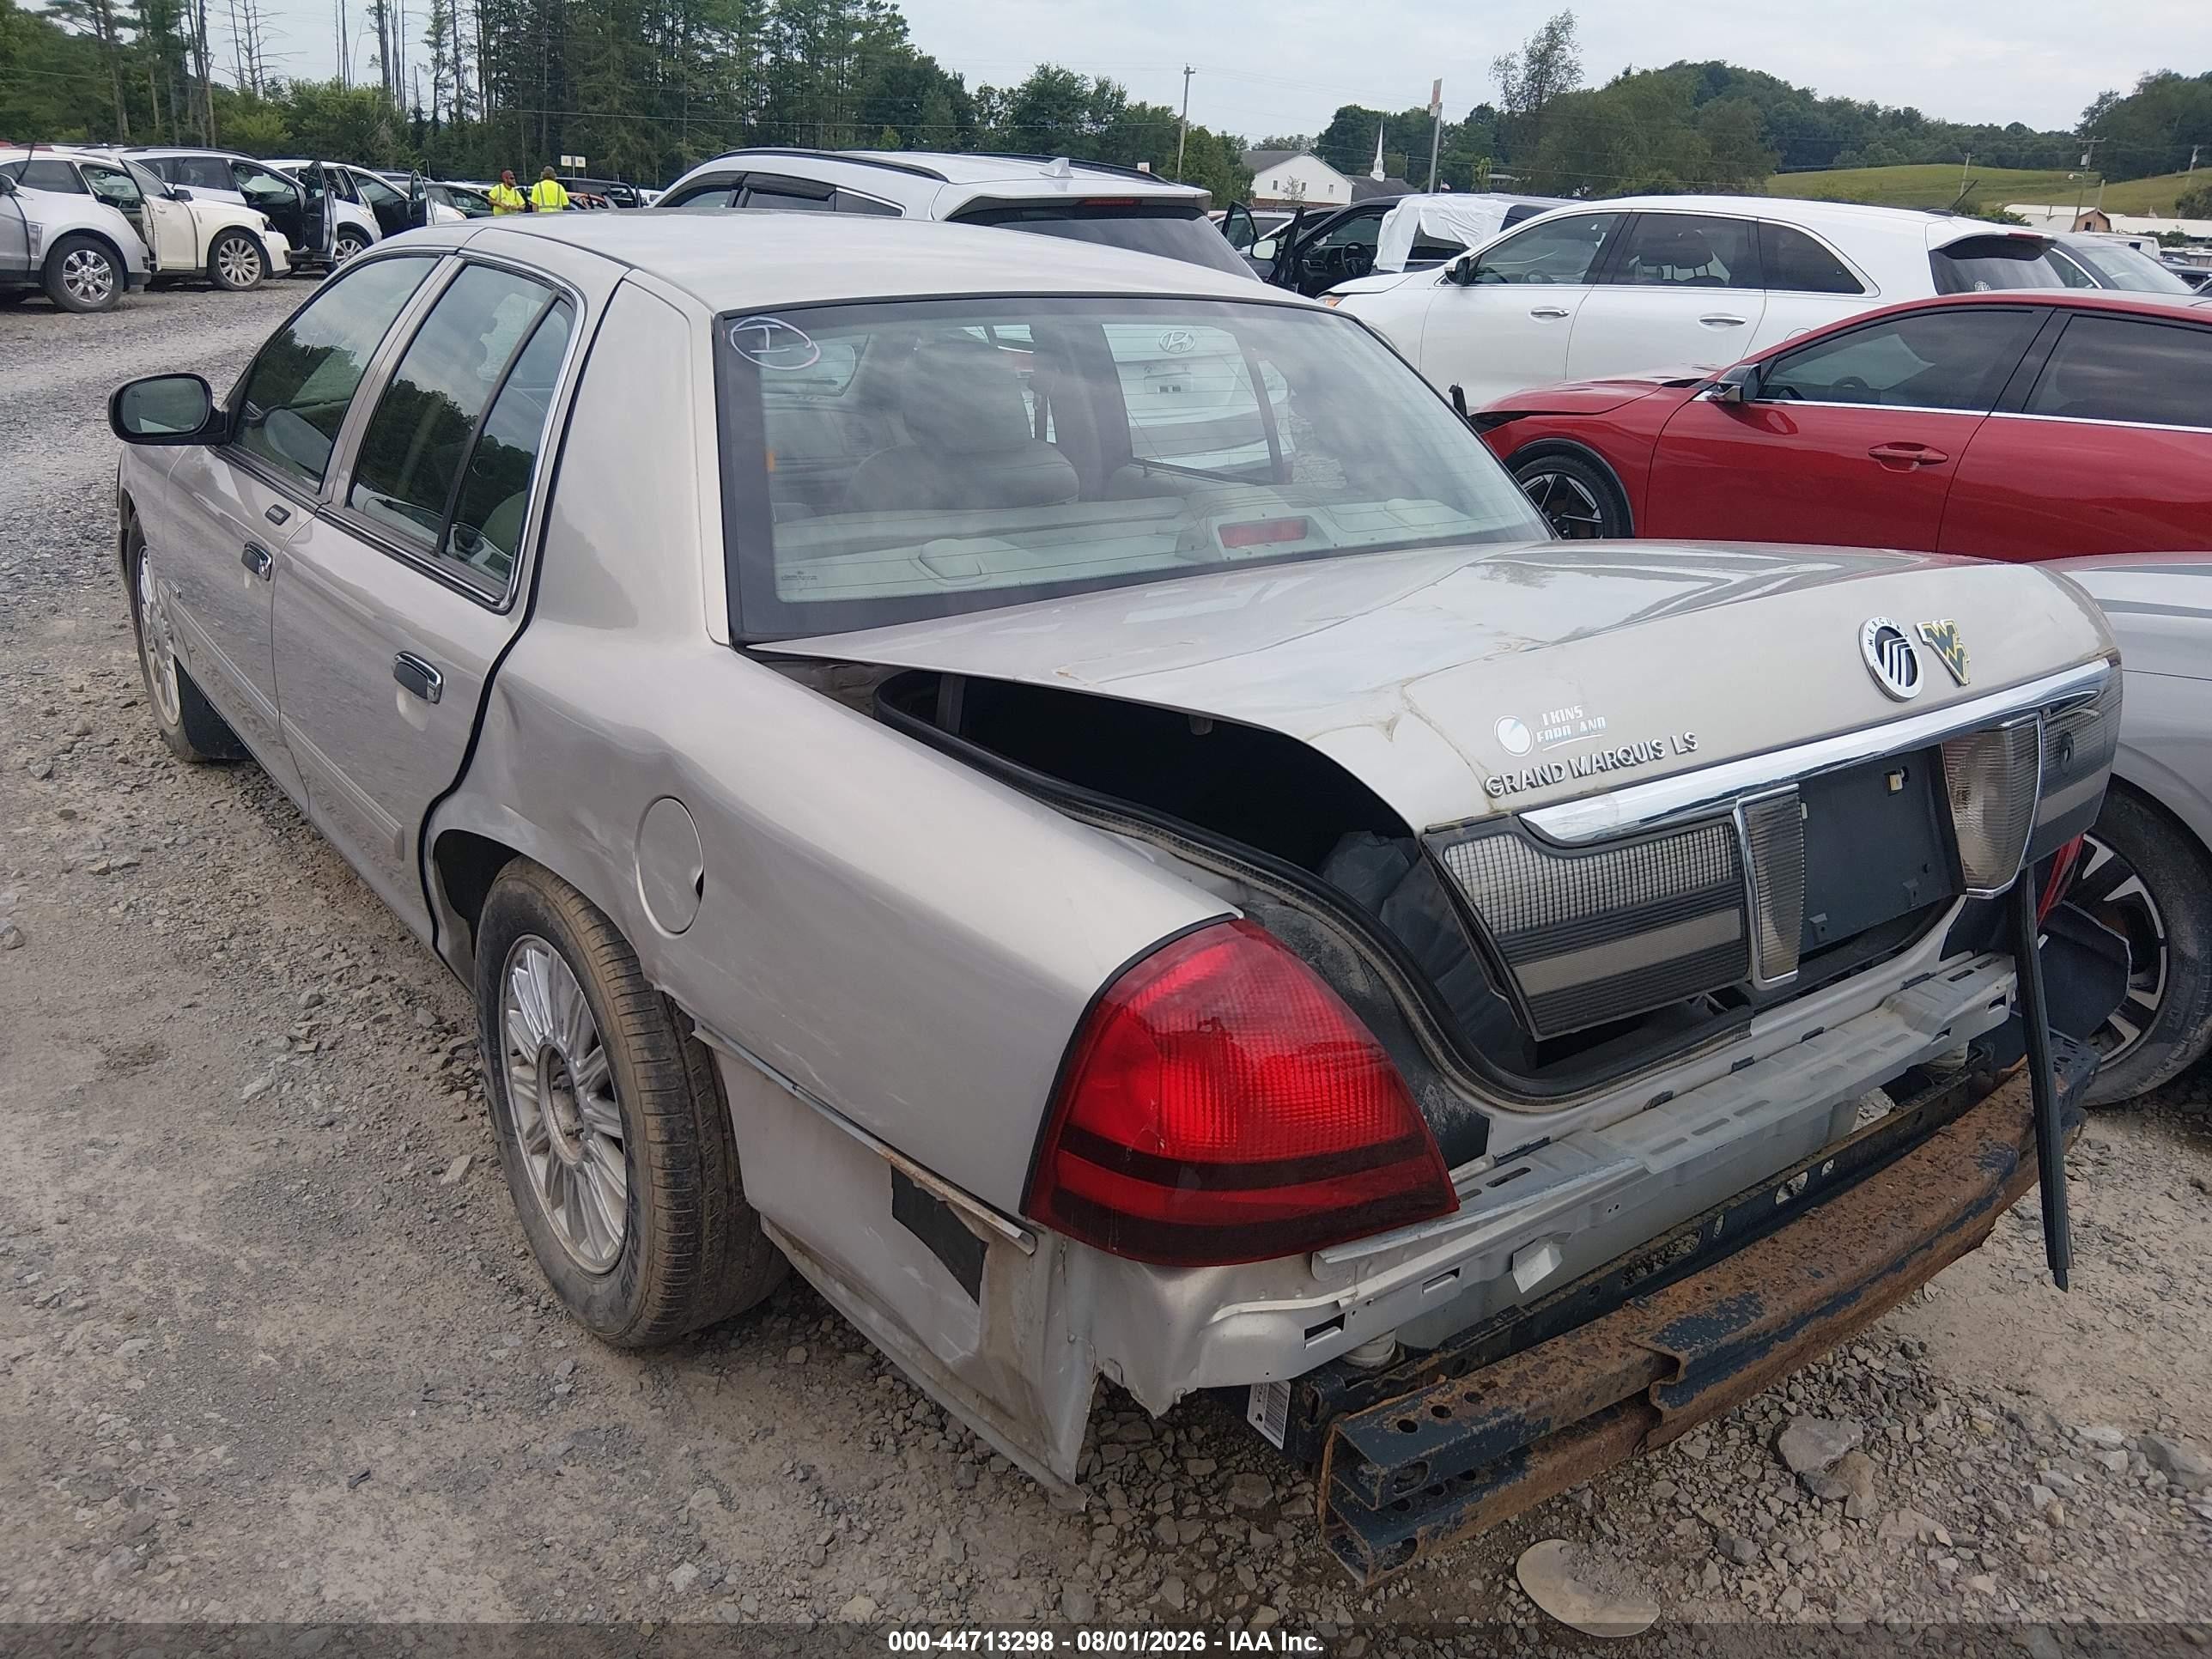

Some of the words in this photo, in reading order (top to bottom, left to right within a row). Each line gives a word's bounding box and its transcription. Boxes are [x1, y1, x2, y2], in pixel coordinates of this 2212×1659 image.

[1484, 763, 1567, 799] GRAND
[1568, 738, 1666, 778] MARQUIS
[1670, 731, 1699, 757] LS
